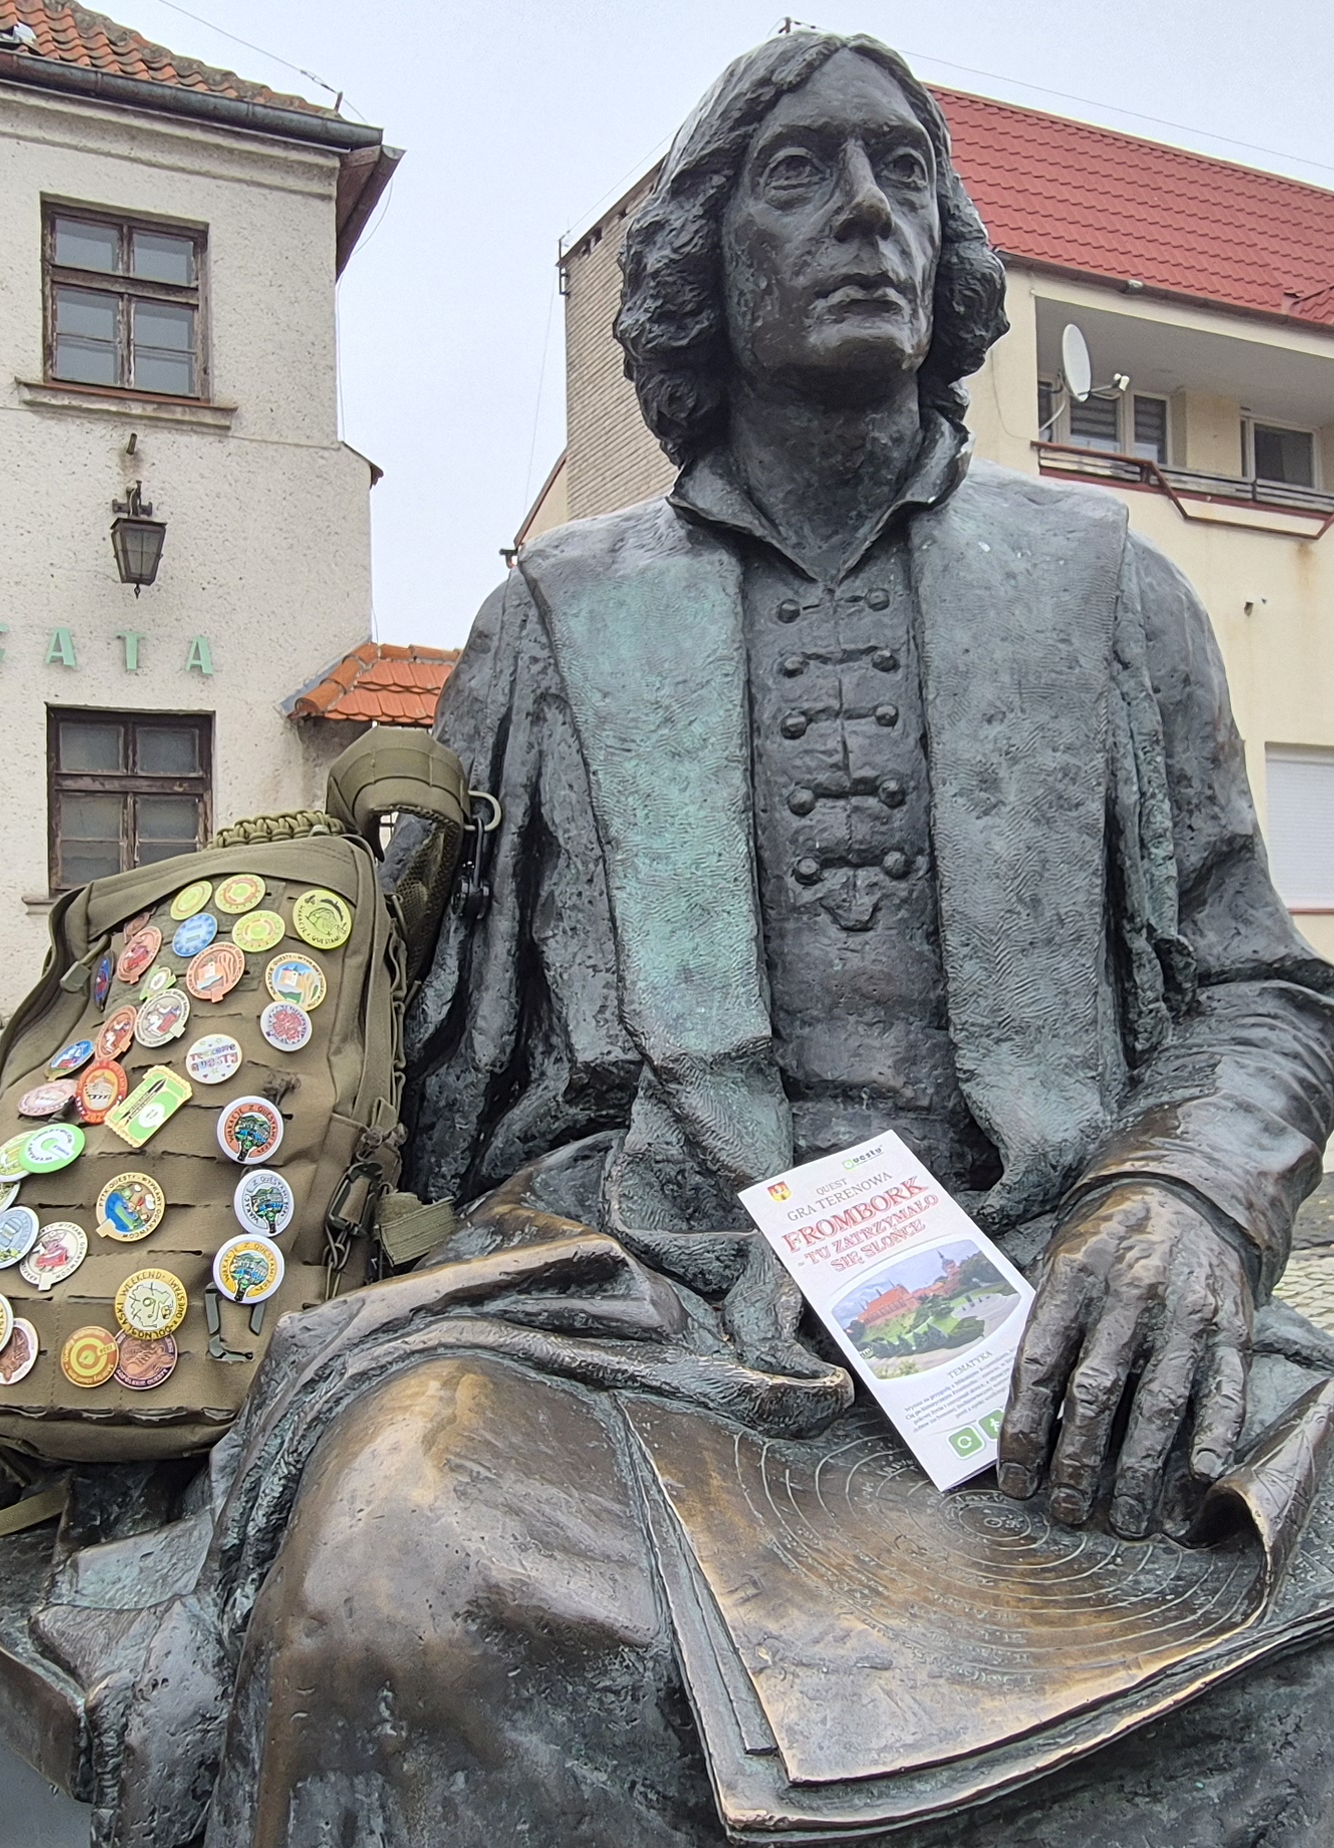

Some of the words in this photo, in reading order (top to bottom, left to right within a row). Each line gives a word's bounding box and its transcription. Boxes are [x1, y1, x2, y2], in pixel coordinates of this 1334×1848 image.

[787, 1206, 817, 1222] GRA
[816, 1171, 893, 1209] TERENOWA
[816, 1178, 848, 1196] QUEST
[781, 1176, 929, 1253] FROMBORK
[805, 1245, 832, 1265] TU
[831, 1194, 939, 1252] ZATRZYMAŁO
[830, 1251, 865, 1272] SIĘ
[861, 1218, 927, 1258] SŁOŃCE
[119, 1271, 162, 1297] WEEKEND
[948, 1350, 993, 1379] TEMATYKA
